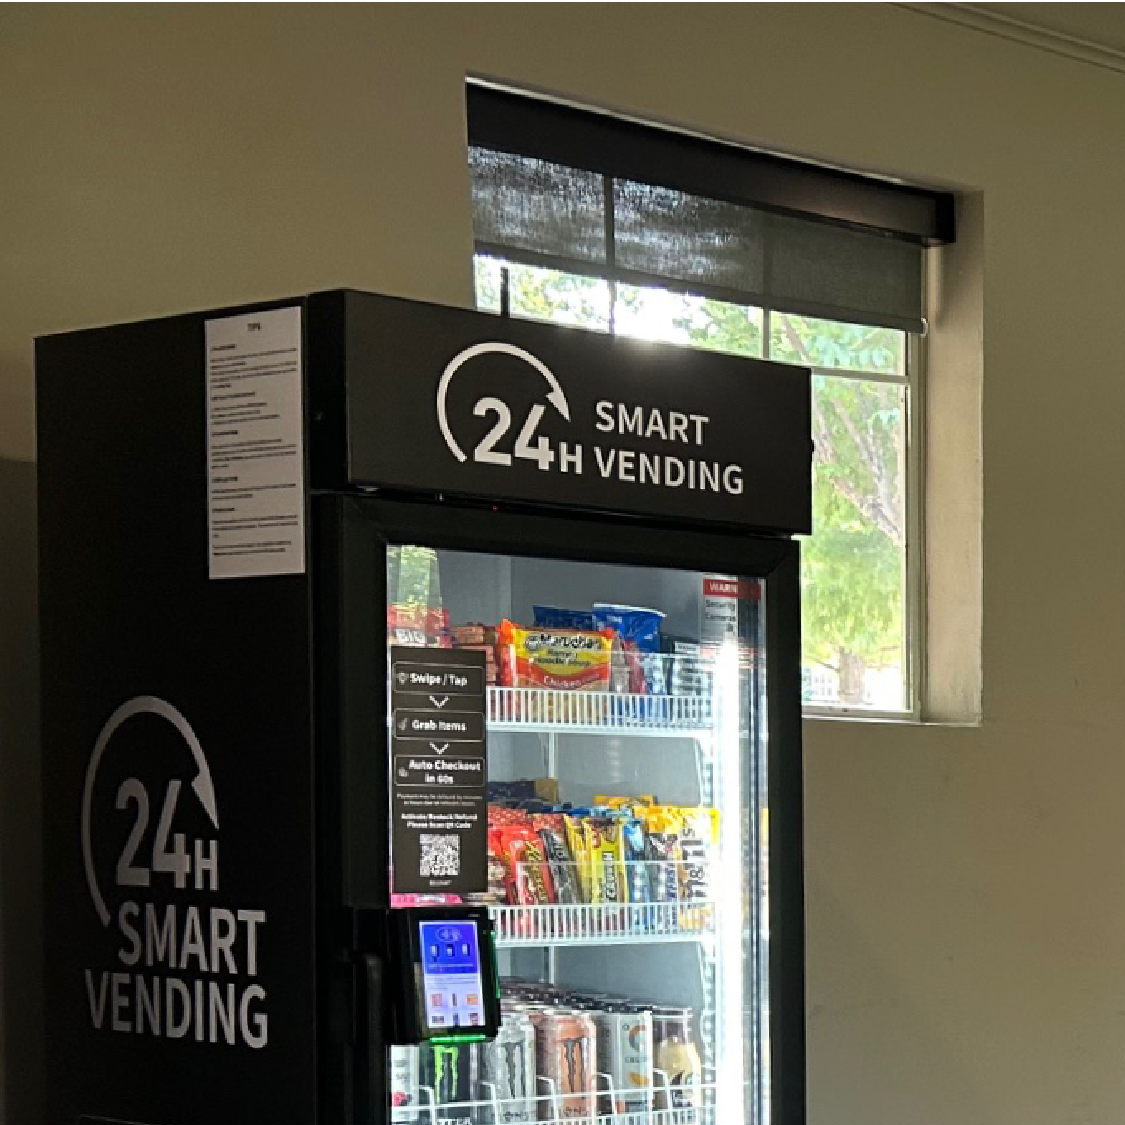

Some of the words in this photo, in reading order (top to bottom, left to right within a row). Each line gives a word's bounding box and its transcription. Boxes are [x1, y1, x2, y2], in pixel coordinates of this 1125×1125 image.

[472, 396, 583, 475] 24H
[595, 400, 710, 445] SMART
[594, 446, 744, 495] VENDING
[410, 673, 441, 686] Swipe
[449, 674, 468, 687] Tap
[412, 719, 437, 731] Grab
[439, 721, 467, 732] Items
[409, 759, 434, 771] Auto
[435, 760, 481, 771] Checkout
[115, 777, 219, 891] 24H
[118, 901, 267, 977] SMART
[85, 968, 268, 1049] VENDING
